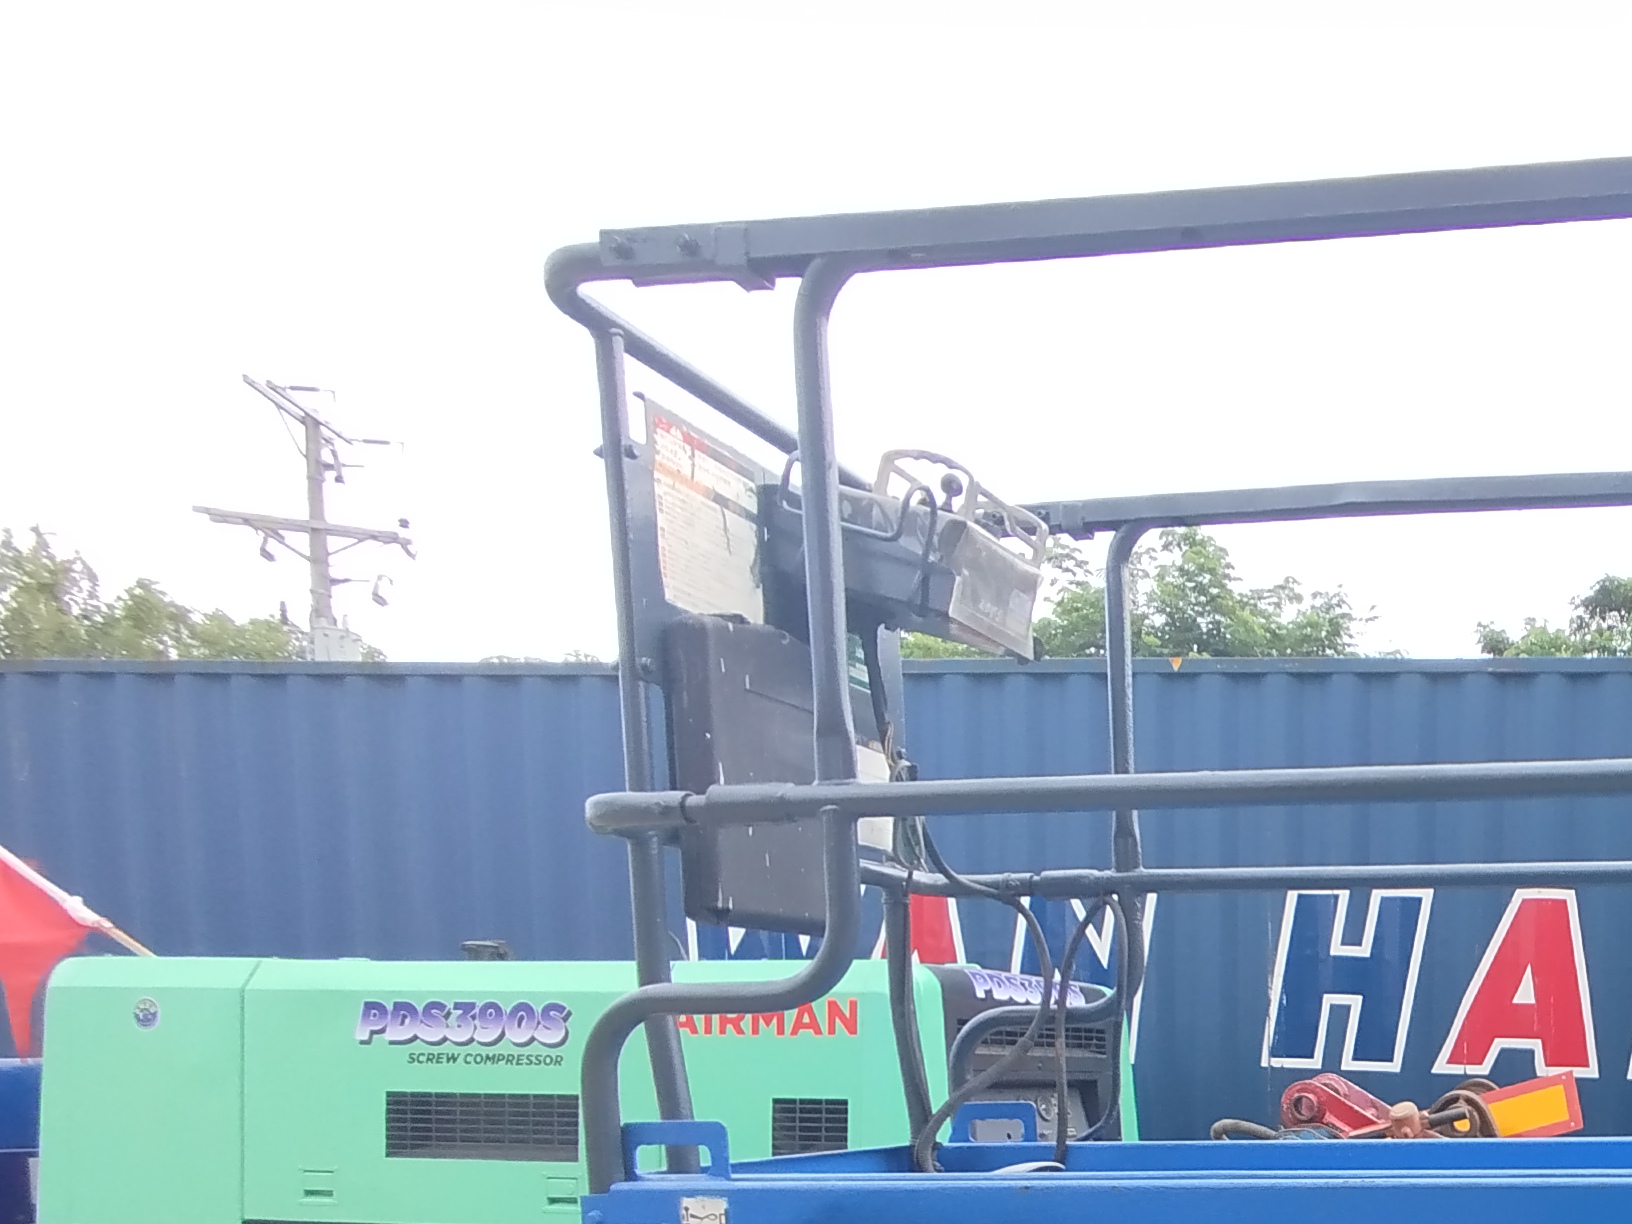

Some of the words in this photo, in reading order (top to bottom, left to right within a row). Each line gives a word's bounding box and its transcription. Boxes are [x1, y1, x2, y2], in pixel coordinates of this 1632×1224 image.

[965, 969, 1086, 1007] PDS3S
[355, 1000, 573, 1049] PDS390S
[407, 1052, 460, 1065] SCREW
[463, 1053, 564, 1067] COMPRESSOR
